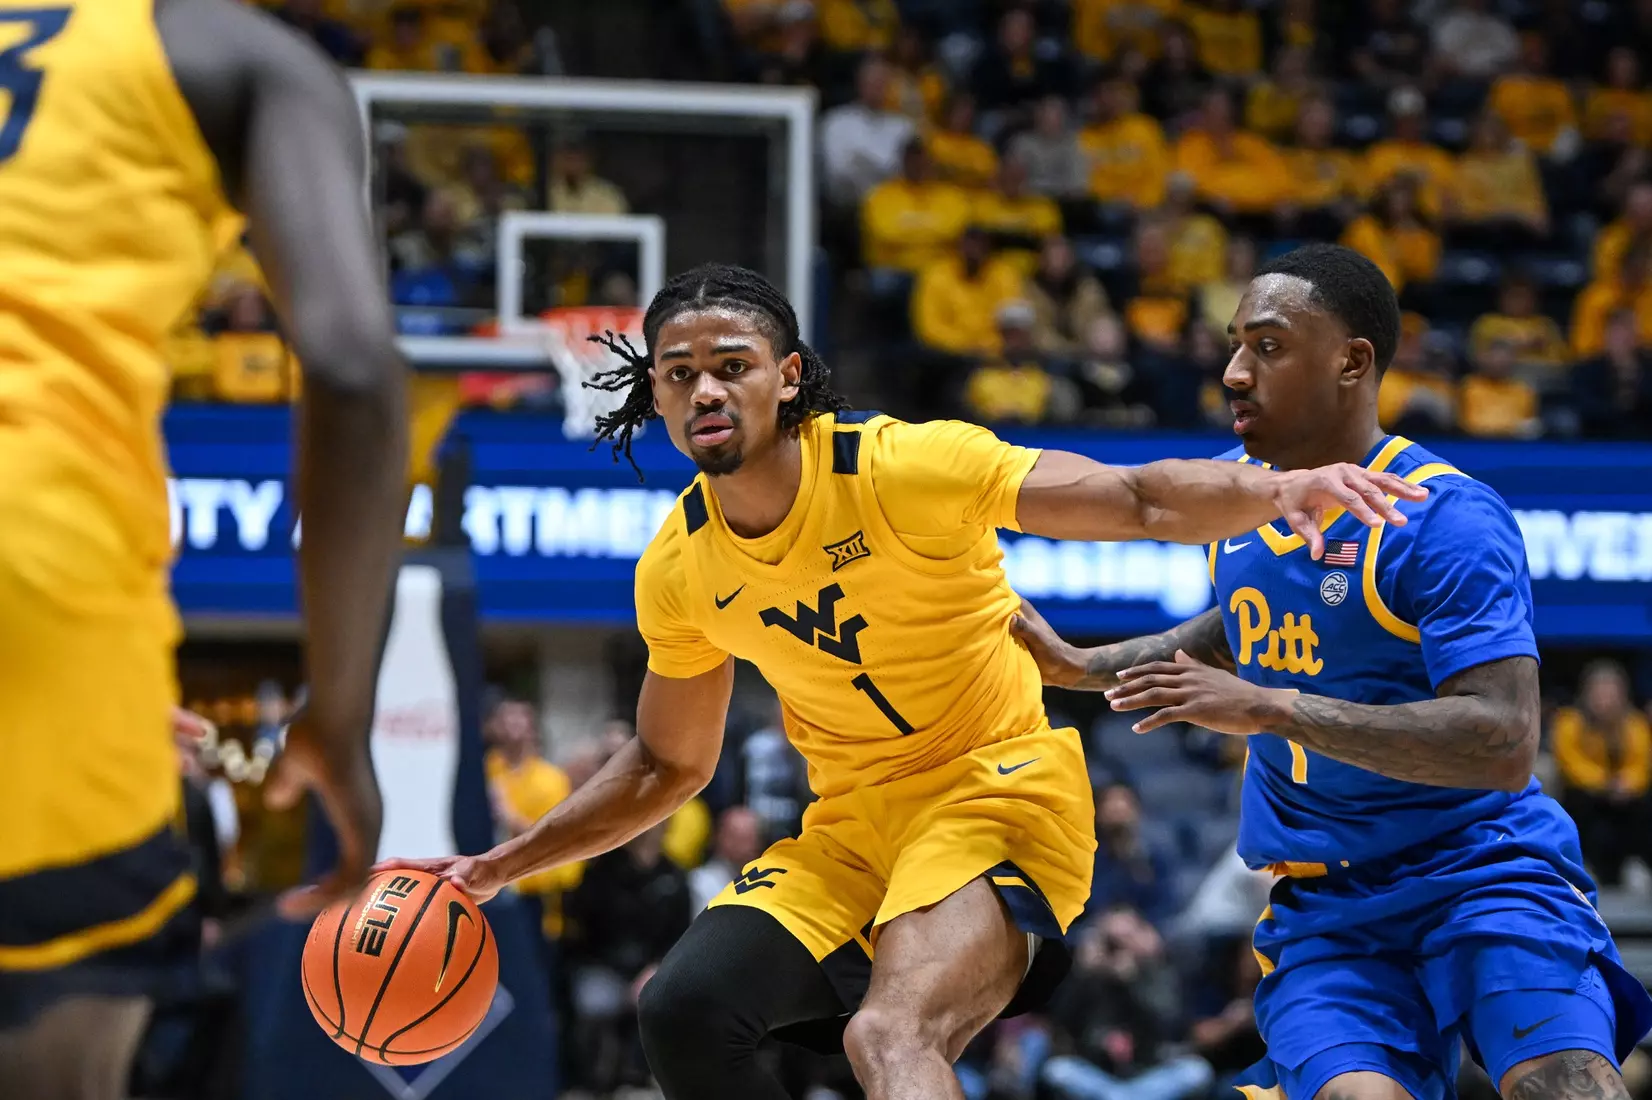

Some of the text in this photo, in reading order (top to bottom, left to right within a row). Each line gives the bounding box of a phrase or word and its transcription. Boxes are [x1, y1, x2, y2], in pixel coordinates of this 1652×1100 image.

[1230, 586, 1324, 676] Pitt
[851, 672, 915, 735] 1
[355, 876, 420, 957] ELITE
